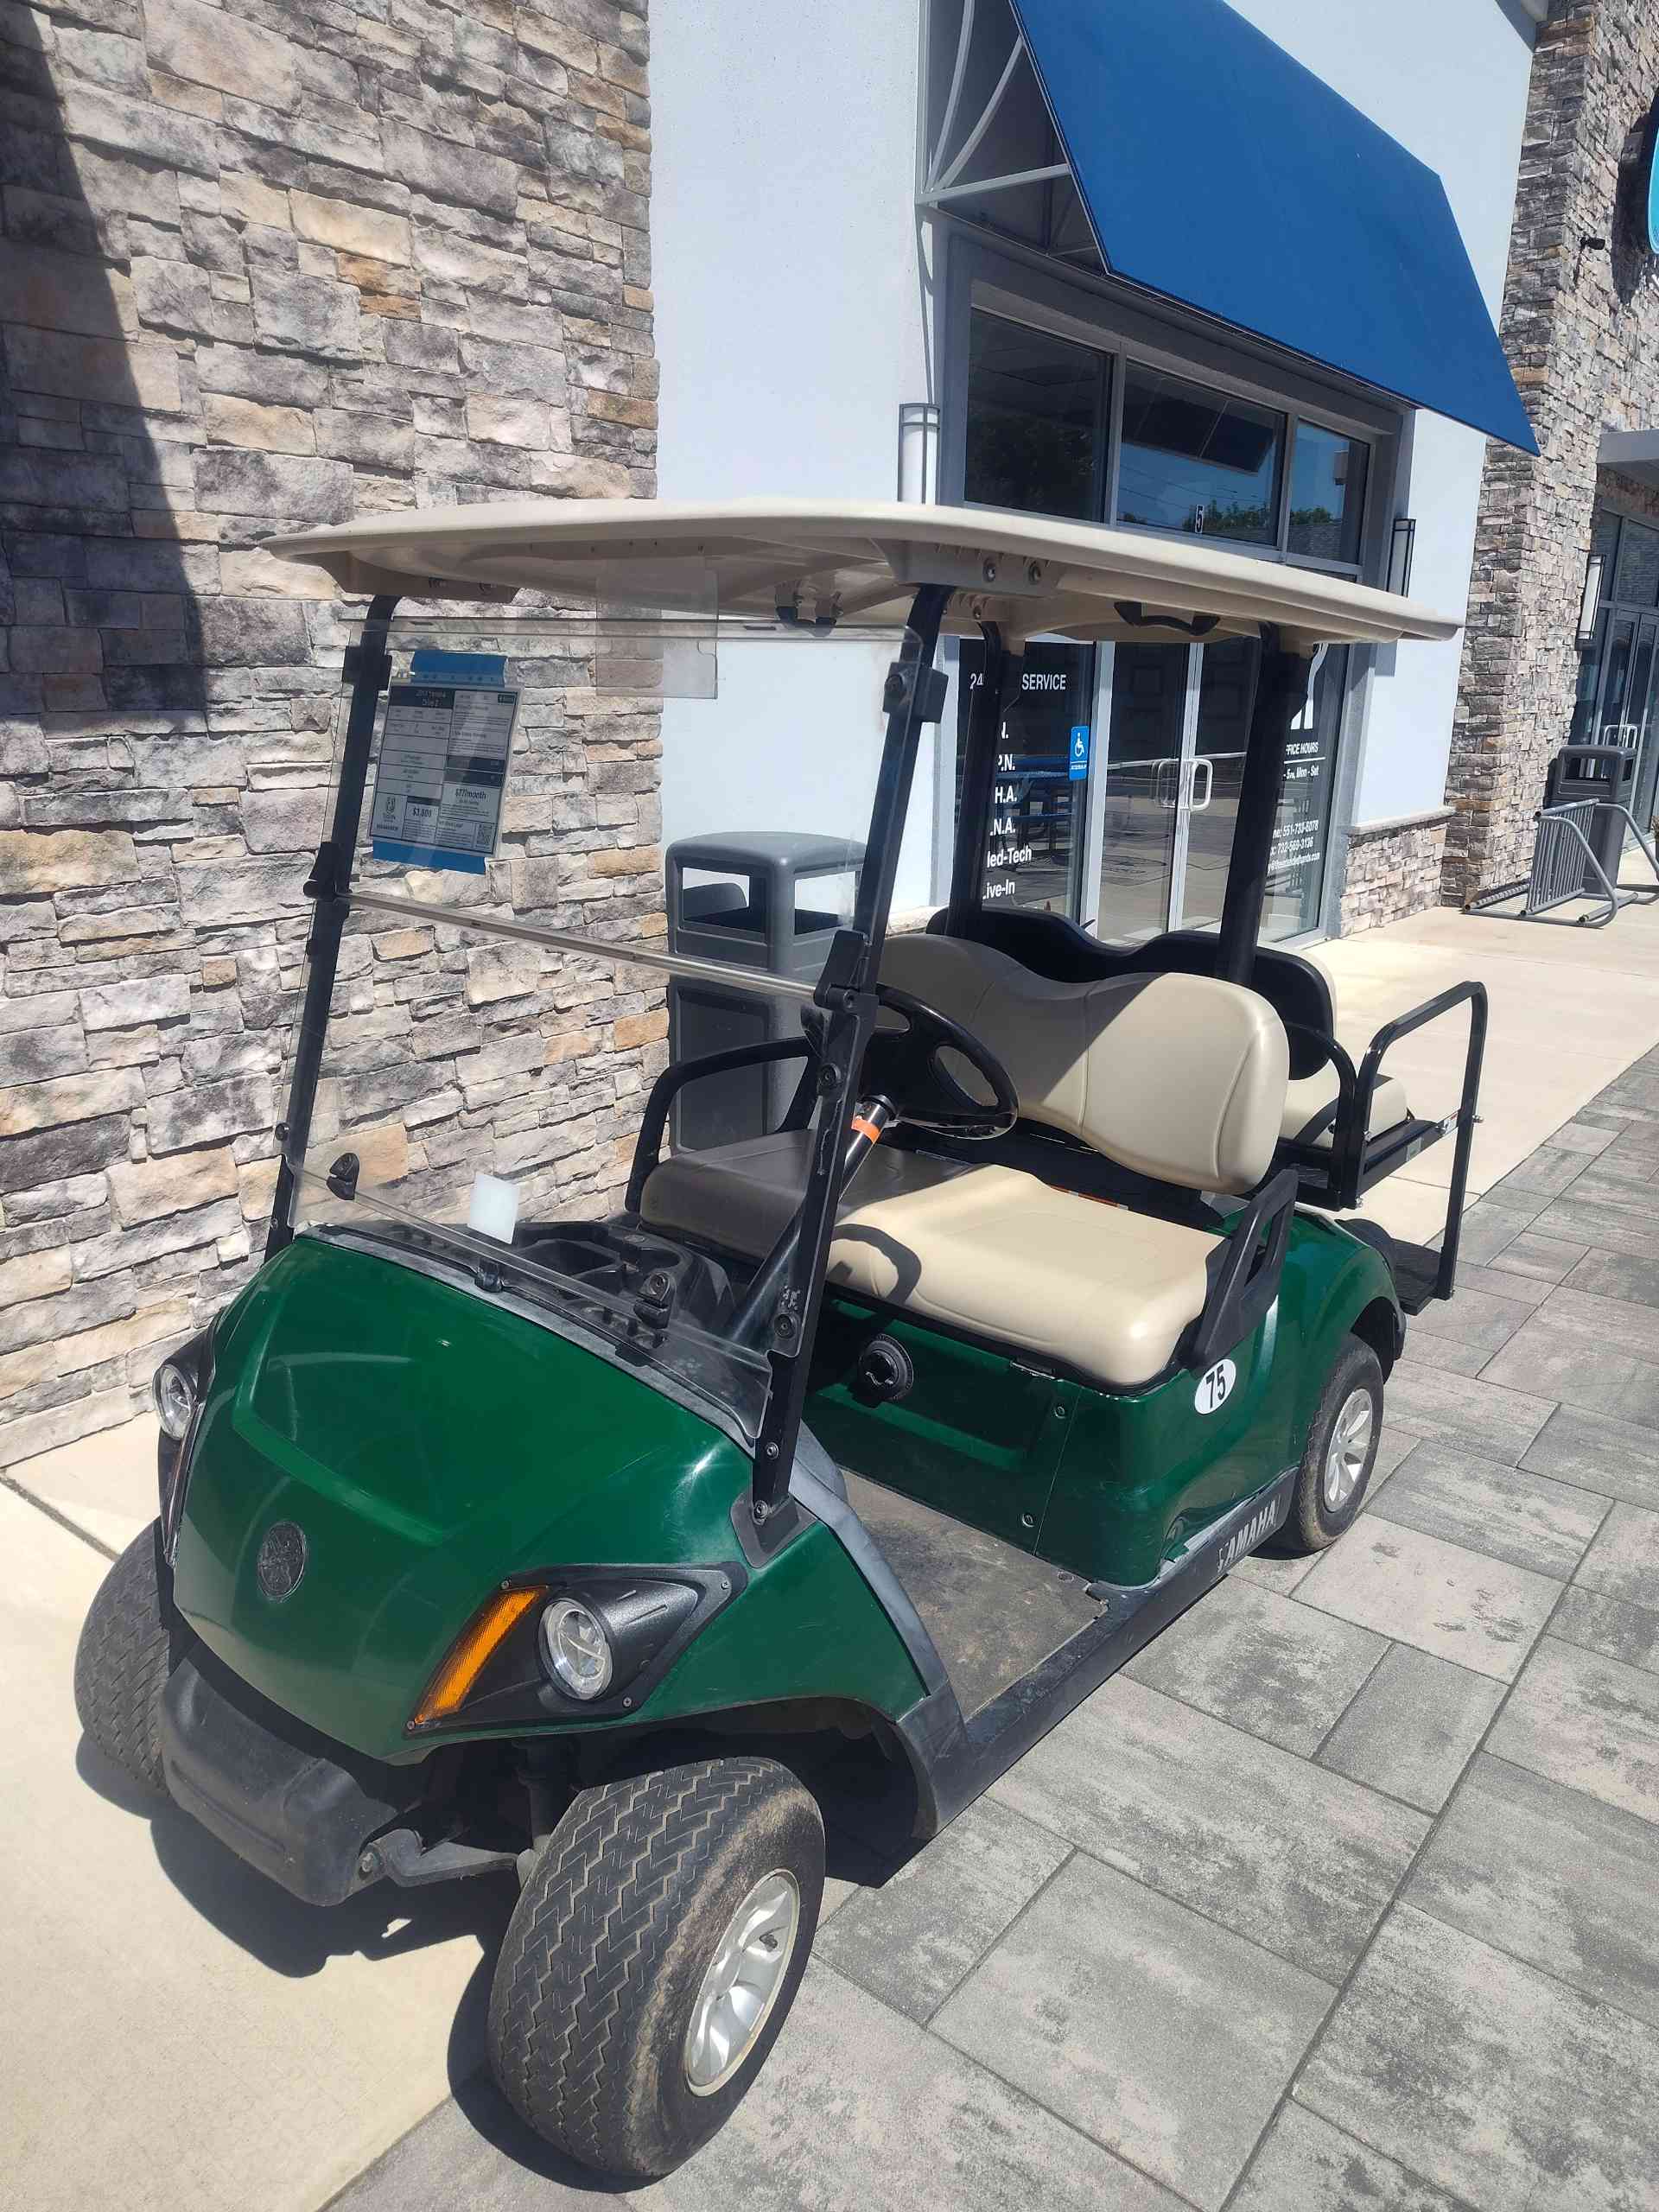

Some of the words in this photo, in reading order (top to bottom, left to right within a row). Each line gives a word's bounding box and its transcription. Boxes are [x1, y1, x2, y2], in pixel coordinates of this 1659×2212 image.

[1021, 673, 1067, 690] SERVICE
[1285, 743, 1300, 755] FICE
[995, 785, 1018, 804] H.A.
[989, 817, 1016, 836] .N.A.
[982, 878, 1016, 899] ive-In
[1205, 1363, 1226, 1409] 75
